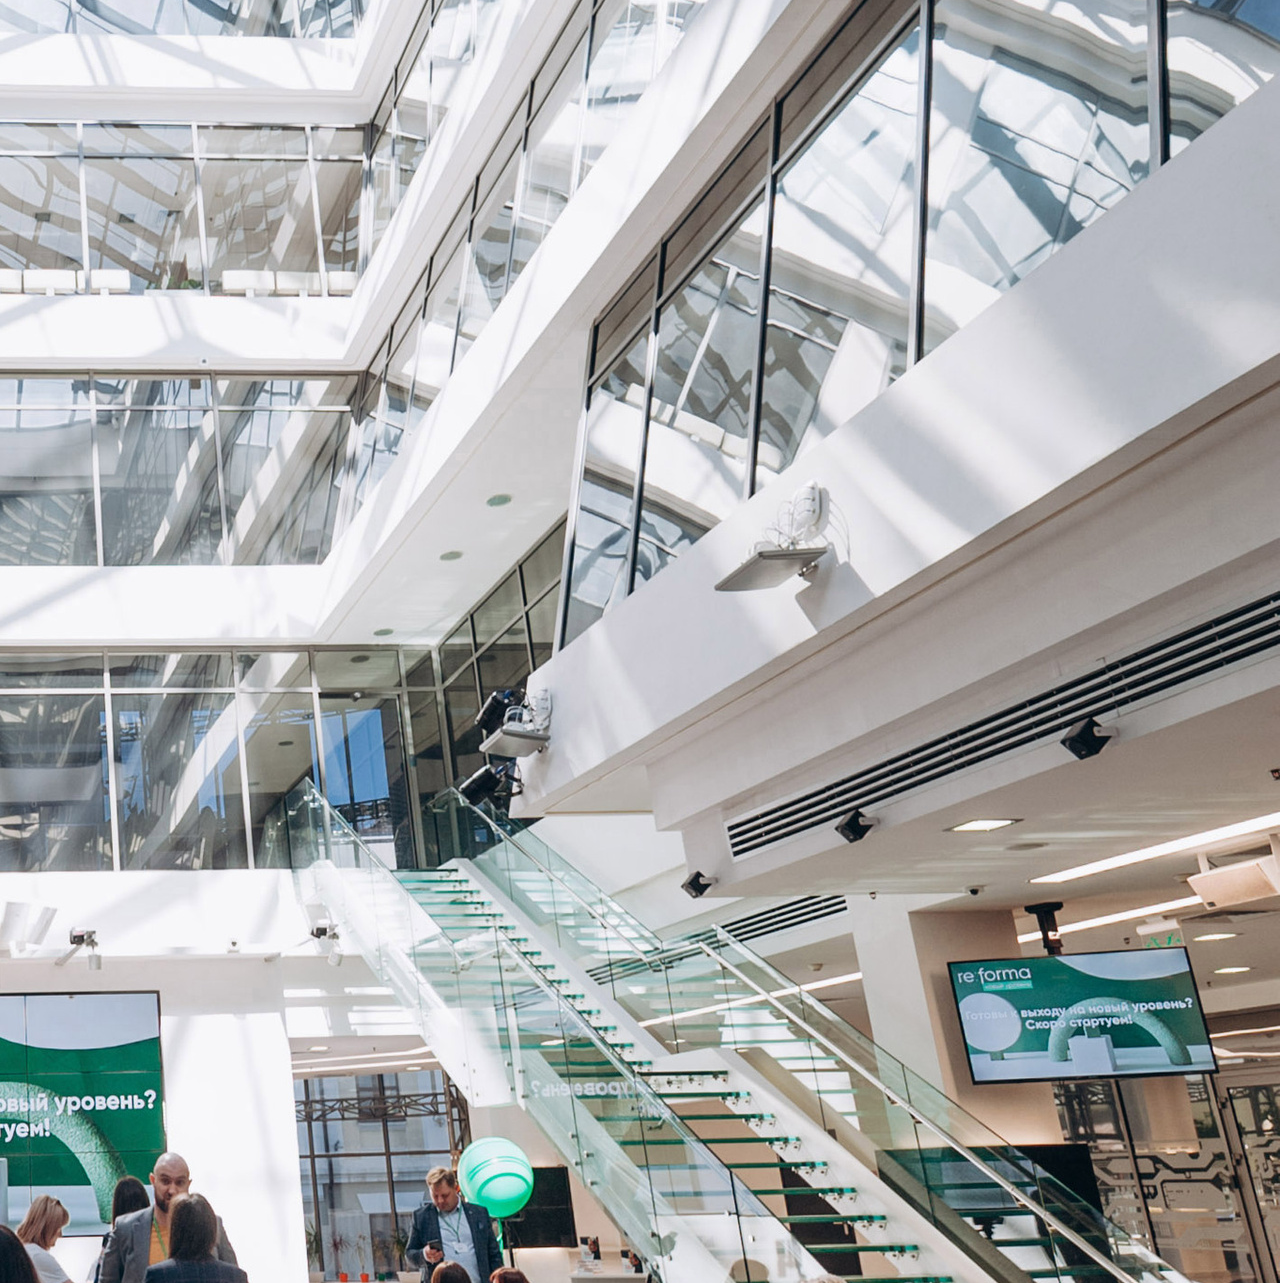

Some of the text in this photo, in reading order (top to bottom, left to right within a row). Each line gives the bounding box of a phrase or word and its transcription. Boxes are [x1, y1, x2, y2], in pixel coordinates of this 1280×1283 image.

[957, 967, 1032, 984] re:forma
[1021, 1007, 1066, 1018] выходу
[1069, 1006, 1086, 1014] на
[1089, 1002, 1129, 1013] новый
[1132, 997, 1193, 1013] уровень?
[1025, 1015, 1133, 1031] Скоро стартуем!
[54, 1089, 157, 1116] уровень?
